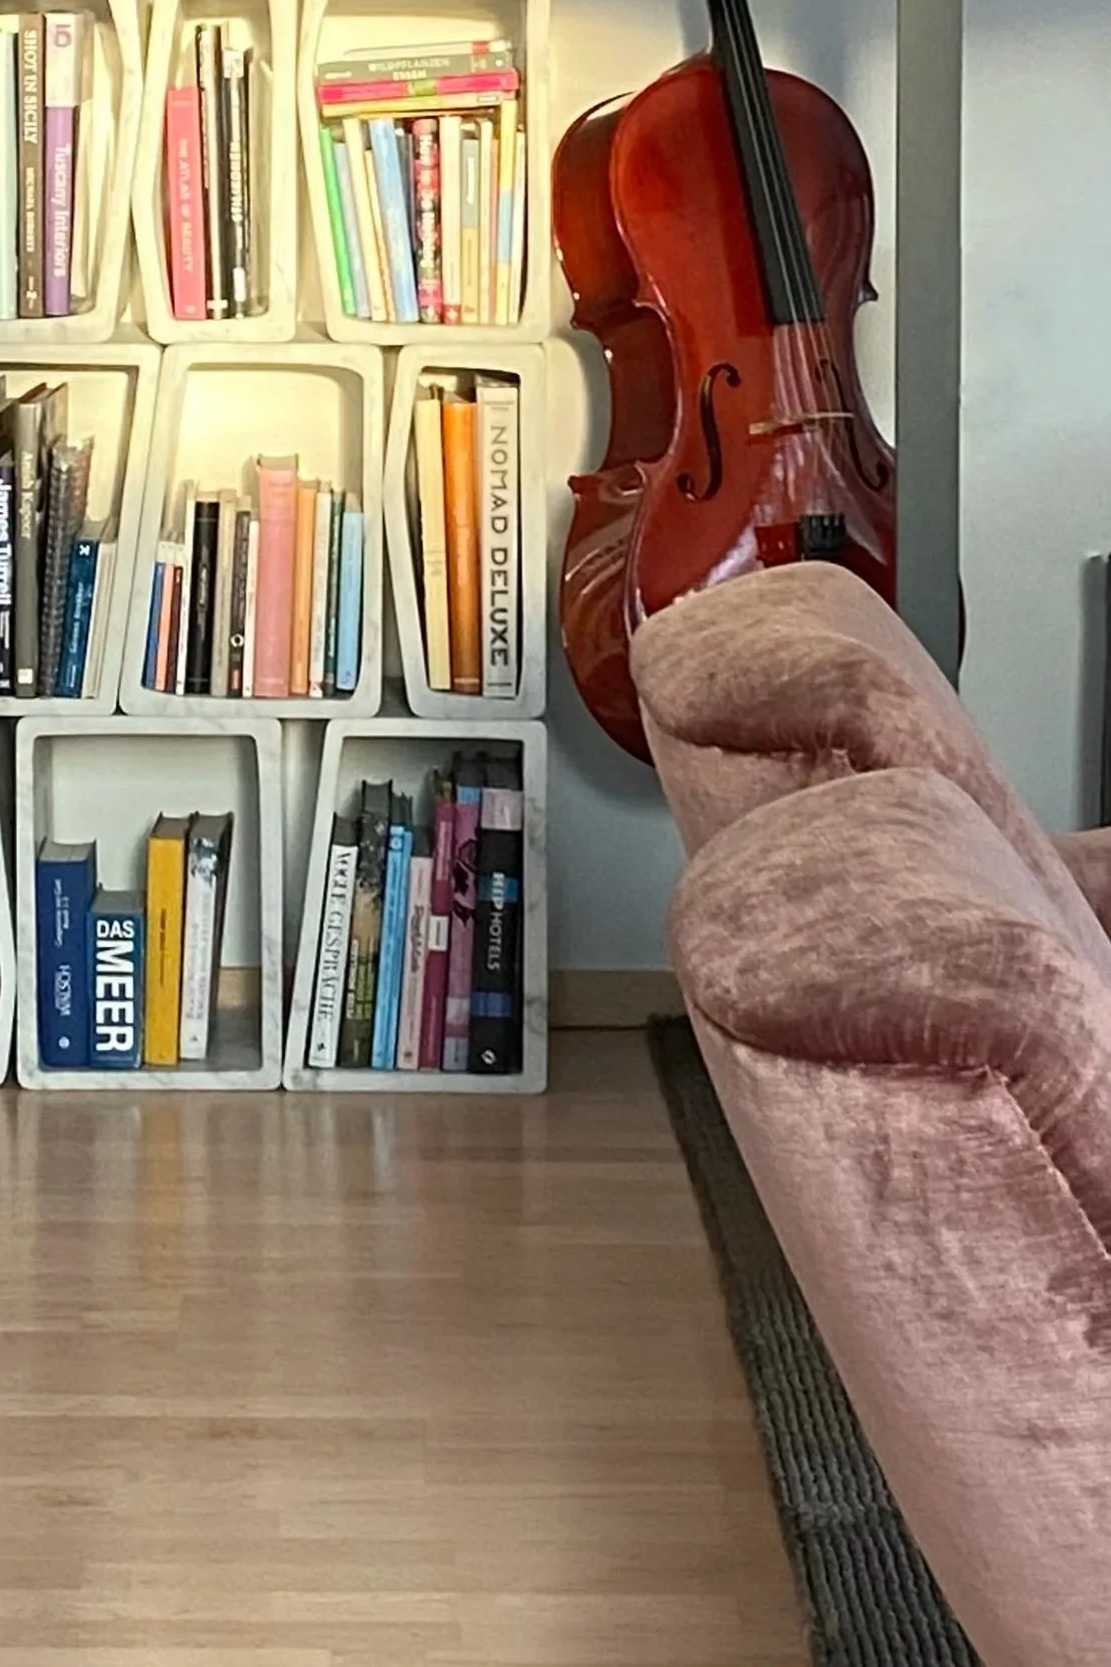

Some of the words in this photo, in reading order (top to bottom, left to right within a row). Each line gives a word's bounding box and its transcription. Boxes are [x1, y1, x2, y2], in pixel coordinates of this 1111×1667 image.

[23, 29, 38, 70] SHOT
[24, 73, 38, 90] IN
[22, 94, 38, 144] SICILY
[51, 143, 72, 203] Tuscany
[177, 159, 192, 199] ATLAS
[52, 210, 70, 277] Interiors
[179, 221, 193, 272] BEAUTY
[21, 450, 35, 488] Anish
[490, 425, 509, 535] NOMAD
[19, 491, 35, 539] Kapoor
[490, 546, 509, 666] DELUXE
[336, 850, 357, 907] VOGUE
[491, 871, 505, 910] HIP
[96, 919, 135, 939] DAS
[487, 910, 504, 972] HOTELS
[317, 909, 352, 1022] GESPRÄCHE
[95, 940, 134, 1052] MEER
